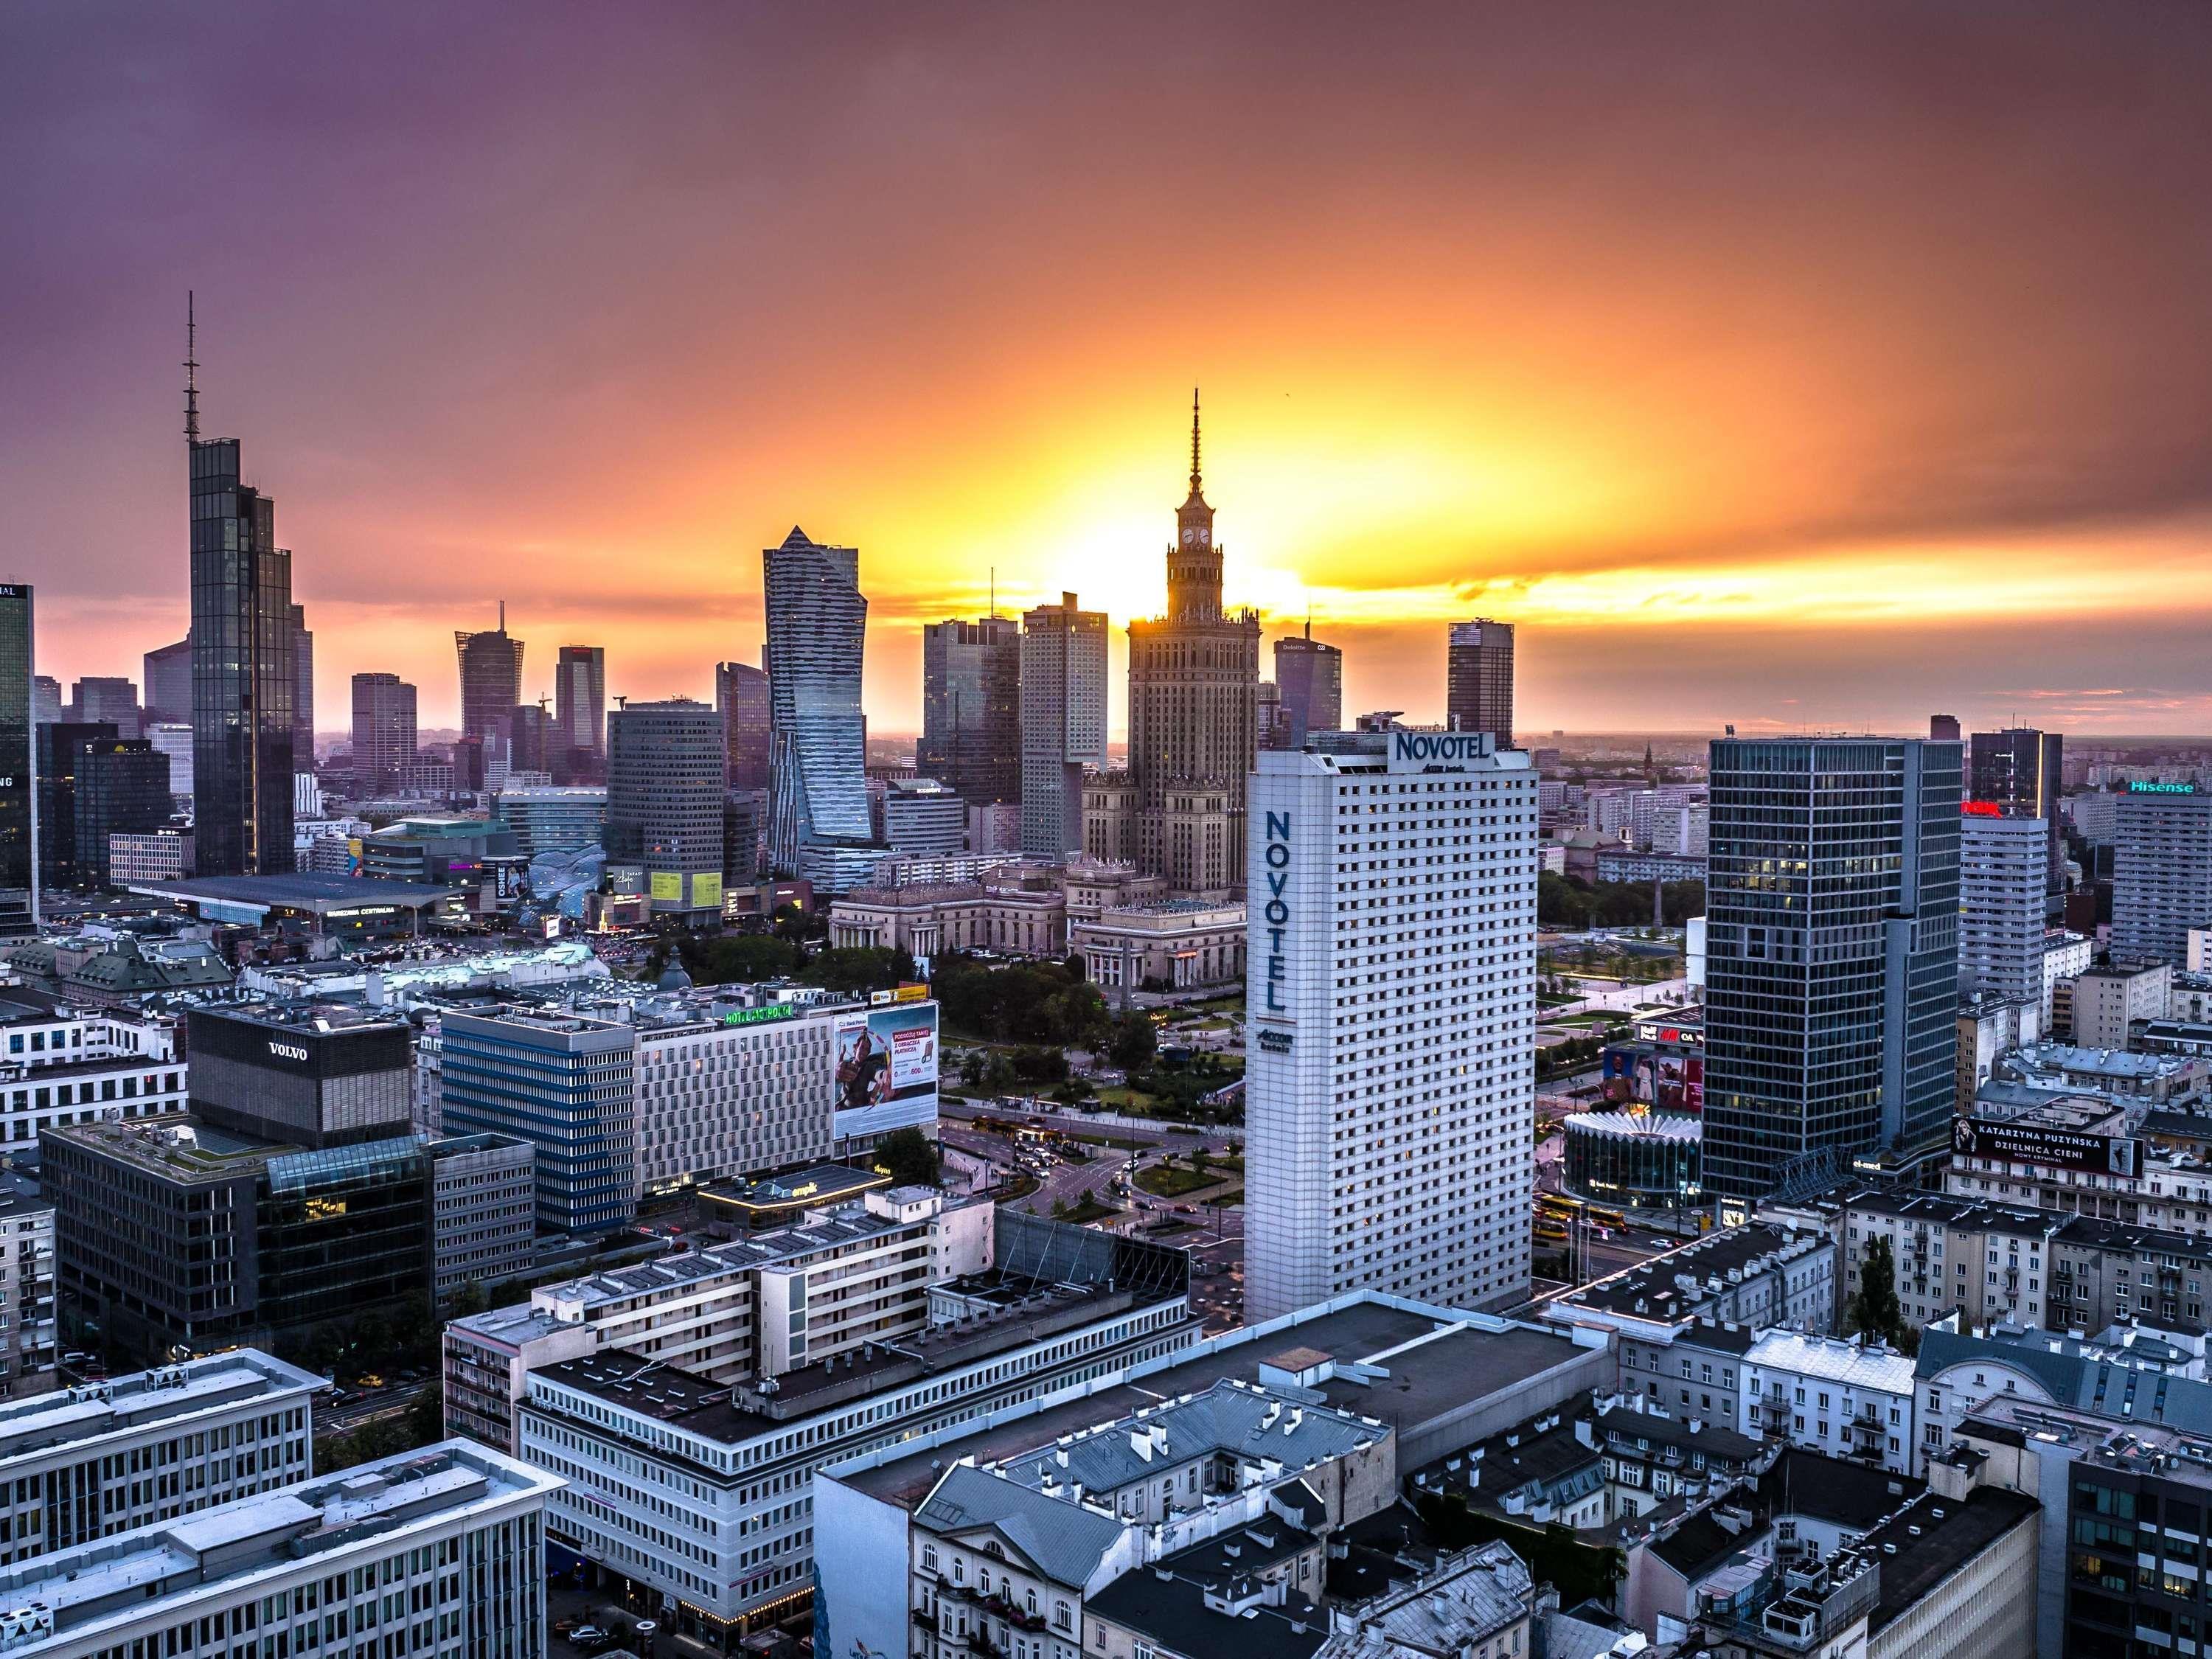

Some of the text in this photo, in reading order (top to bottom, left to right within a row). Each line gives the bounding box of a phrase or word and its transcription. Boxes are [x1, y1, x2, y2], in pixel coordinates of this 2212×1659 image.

[1396, 732, 1491, 761] NOVOTEL
[2131, 781, 2194, 793] Hisense
[498, 867, 506, 897] OSHEE
[361, 907, 394, 915] CENTRALNA
[1265, 810, 1290, 1012] NOVOTEL
[726, 1005, 792, 1023] HOTEL METROPOL
[268, 1042, 307, 1061] VOLVO
[1979, 1125, 2101, 1149] KATARZYNA PUZYŃSKA
[1994, 1141, 2083, 1160] DZIELNICA CIENI
[2033, 1155, 2063, 1164] KRYMINAŁ
[792, 1181, 818, 1197] empik
